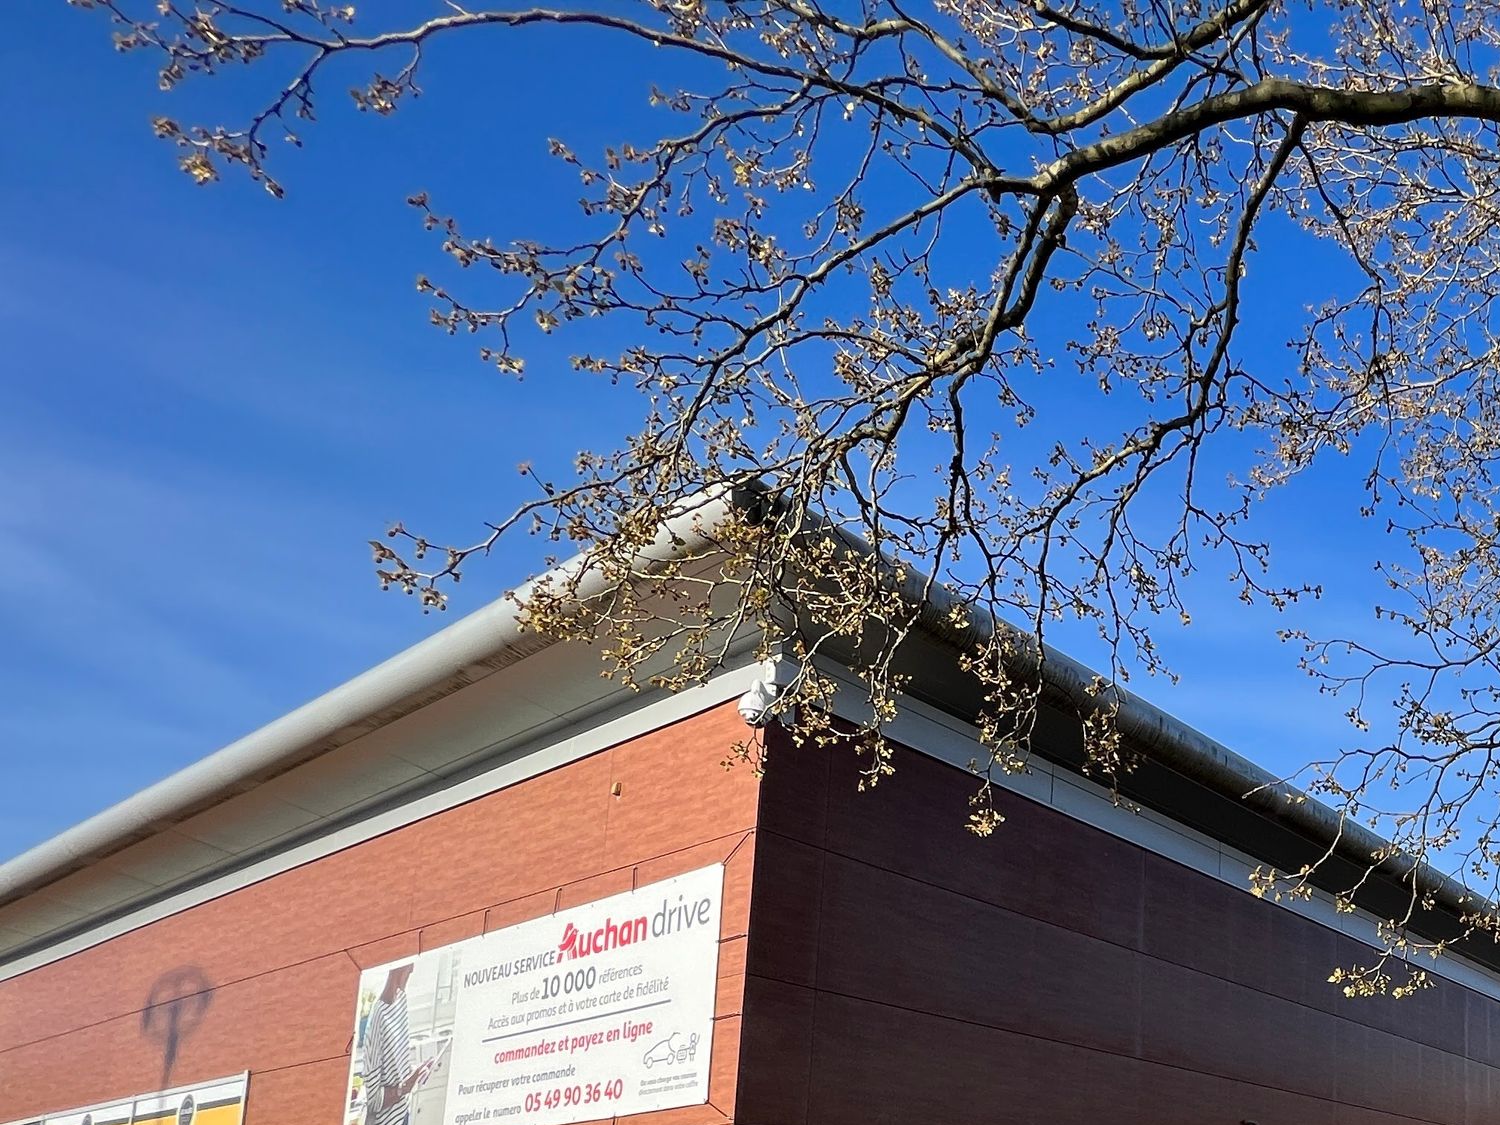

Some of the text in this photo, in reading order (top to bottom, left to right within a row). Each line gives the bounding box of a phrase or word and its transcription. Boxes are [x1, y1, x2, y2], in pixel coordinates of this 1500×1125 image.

[464, 895, 711, 988] NOUVEAU SERVICE Auchan drive
[488, 976, 669, 1030] Accès aux promos et à votre carte de fidélité
[512, 964, 643, 1005] Plus de 10 000 références
[494, 1020, 653, 1064] commandez et payez en ligne
[458, 1084, 474, 1095] Pour
[511, 1075, 531, 1087] votre
[532, 1064, 576, 1083] commande
[483, 1107, 491, 1119] le
[524, 1092, 541, 1113] 05
[544, 1089, 561, 1109] 49
[564, 1085, 581, 1107] 90
[584, 1082, 601, 1104] 36
[604, 1078, 624, 1100] 40
